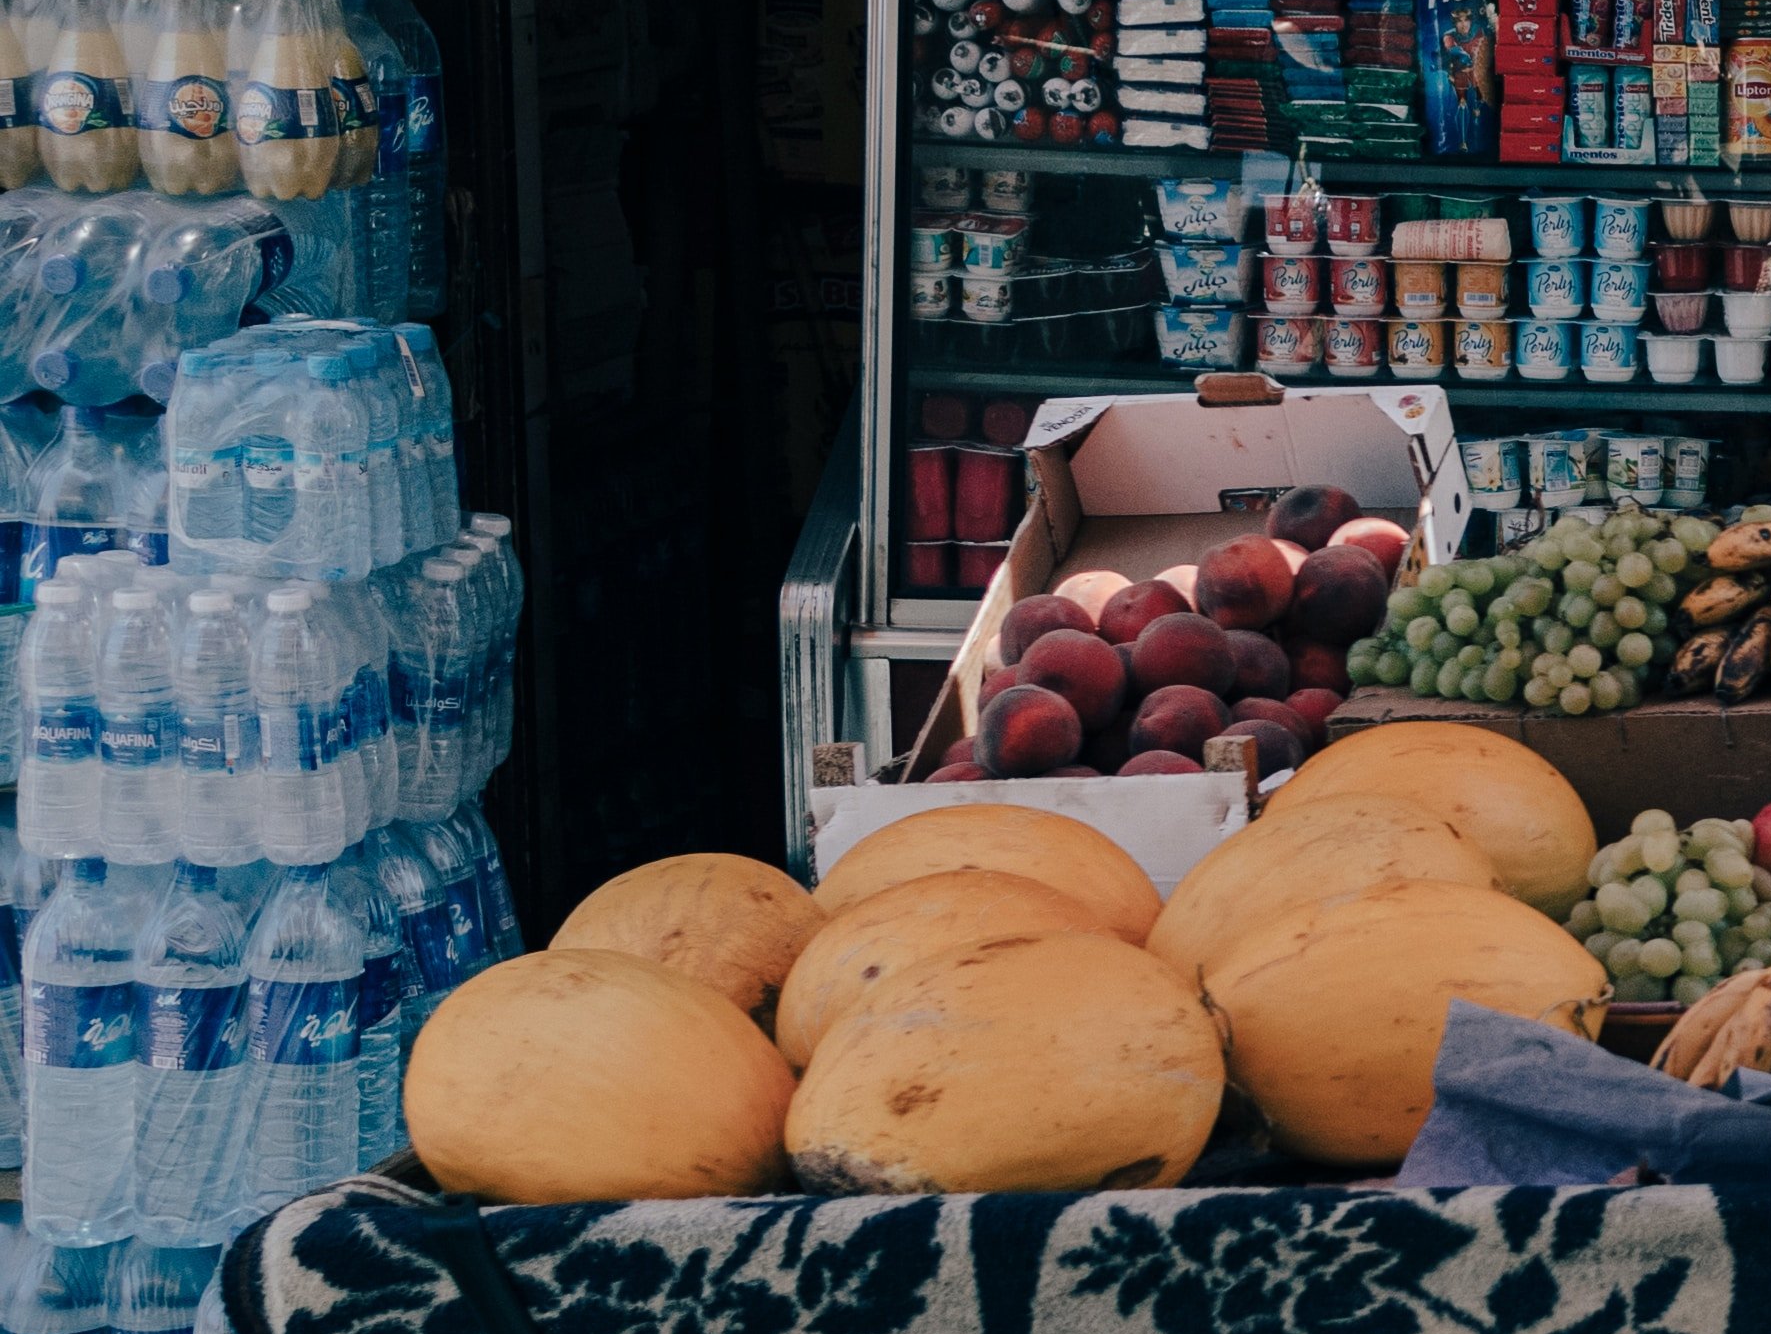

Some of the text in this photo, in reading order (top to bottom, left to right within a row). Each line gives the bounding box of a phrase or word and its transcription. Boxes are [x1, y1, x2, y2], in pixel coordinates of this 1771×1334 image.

[1567, 47, 1615, 59] mentos
[1569, 150, 1618, 160] mentos
[1535, 211, 1574, 239] Perly
[1601, 213, 1641, 244] Perly
[1272, 265, 1310, 294] Perly
[1343, 268, 1380, 297] Perly
[1536, 271, 1576, 299] Perly
[1597, 271, 1637, 301] Perly
[1262, 324, 1298, 353] Perly
[1327, 328, 1362, 356] Perly
[1395, 326, 1433, 357] Perly
[1457, 326, 1496, 358] Perly
[1523, 332, 1563, 361] Perly
[1585, 332, 1626, 361] Perly
[32, 725, 92, 743] AQUAFINA
